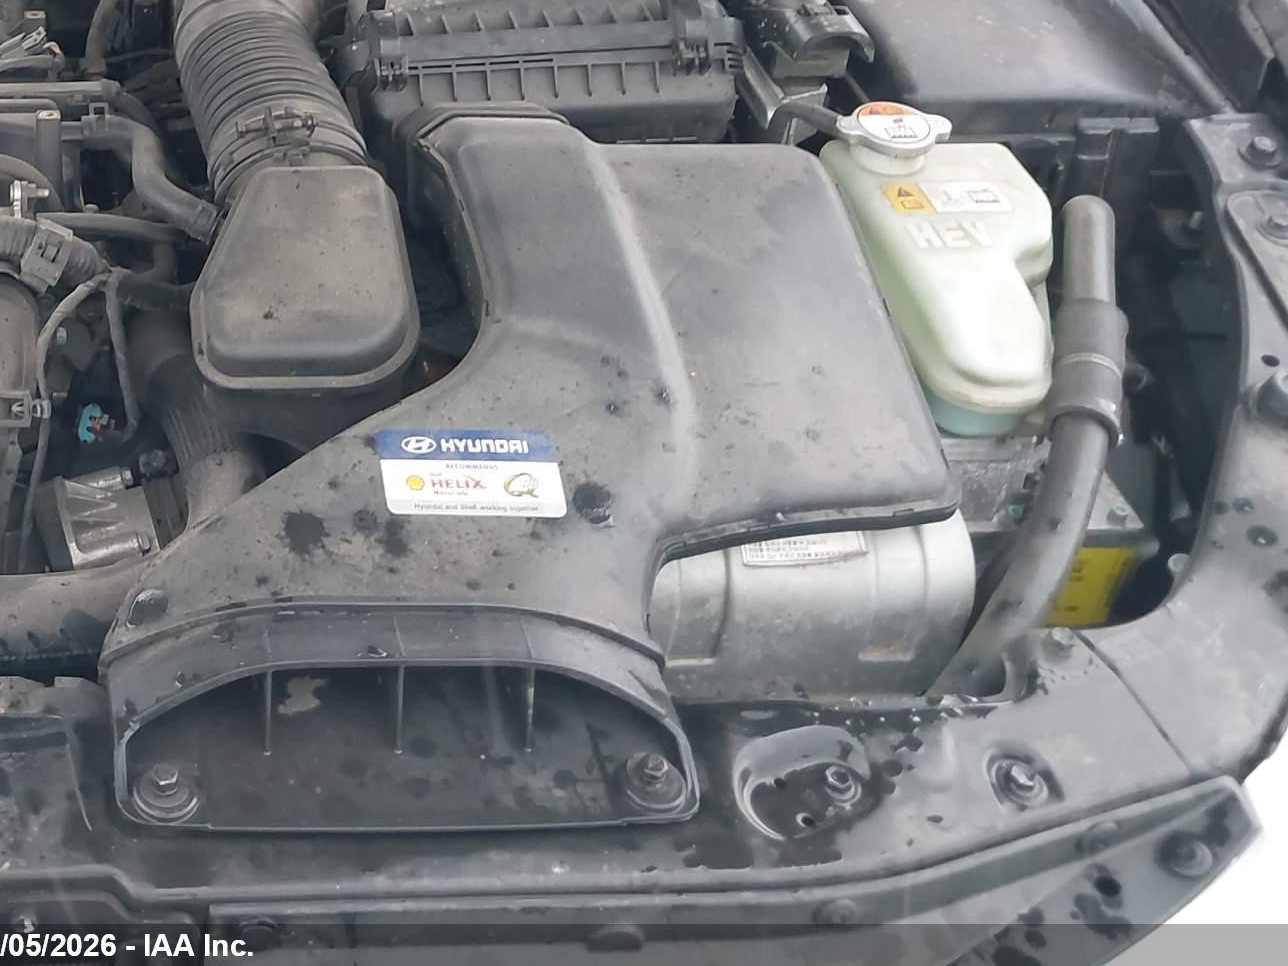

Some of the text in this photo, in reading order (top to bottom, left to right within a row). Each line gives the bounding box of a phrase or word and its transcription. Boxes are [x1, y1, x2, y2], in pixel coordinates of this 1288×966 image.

[904, 220, 992, 249] HEV
[440, 438, 529, 454] HYUNDAI
[431, 475, 487, 490] HELIX
